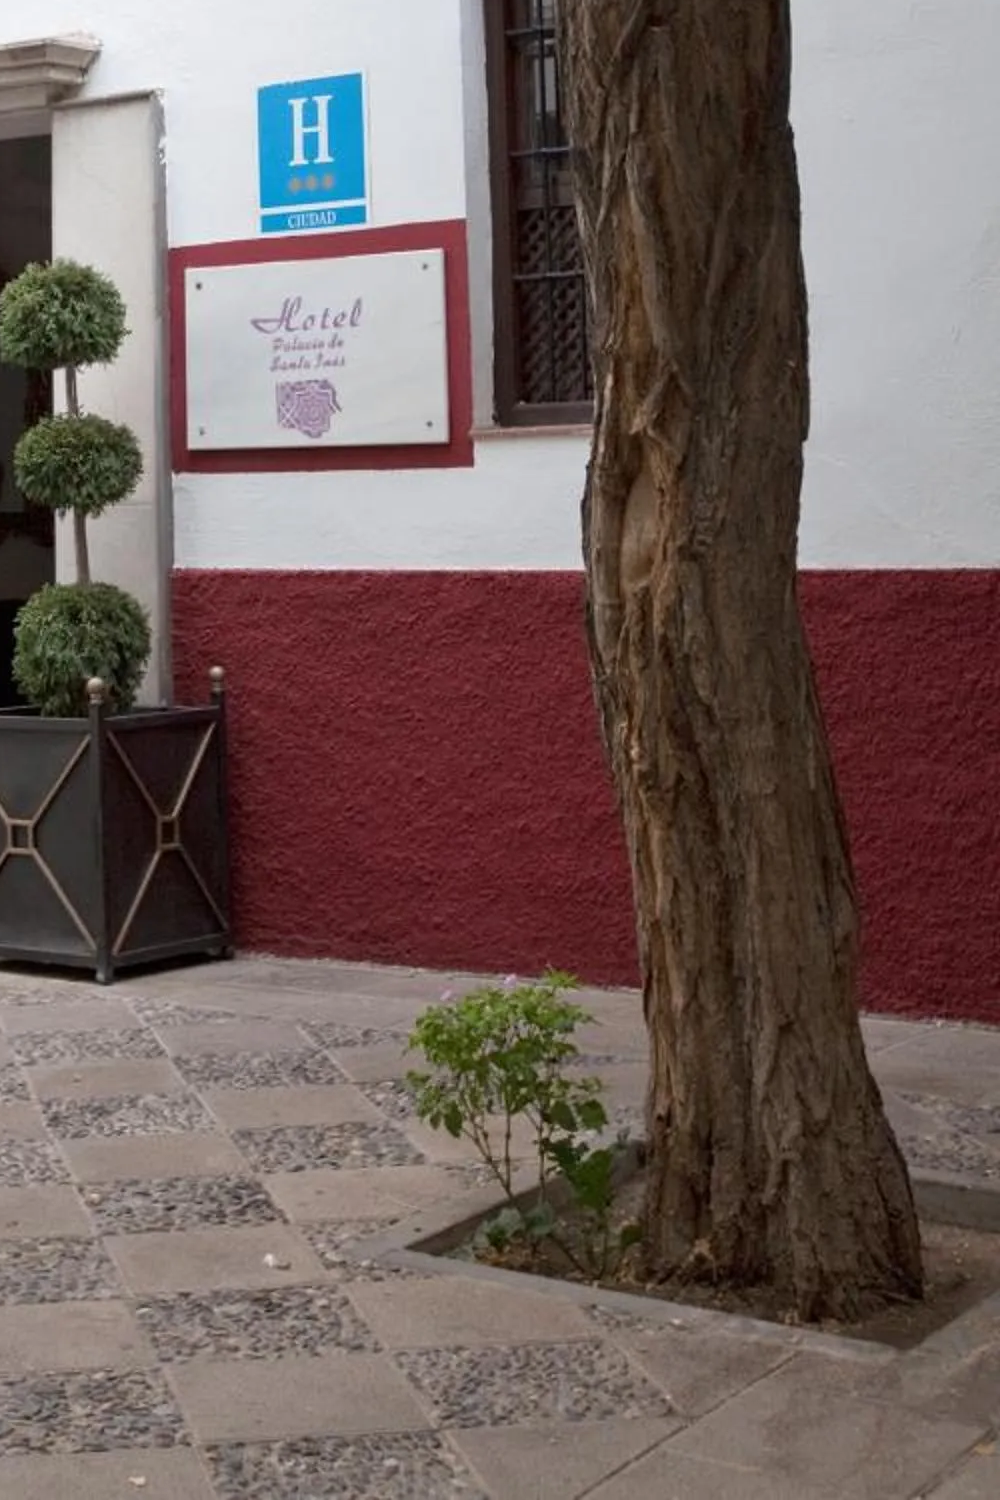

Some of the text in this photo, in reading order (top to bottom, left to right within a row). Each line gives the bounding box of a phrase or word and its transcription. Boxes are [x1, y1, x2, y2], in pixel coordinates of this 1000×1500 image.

[288, 94, 335, 167] H
[287, 211, 337, 229] CIUDAD
[250, 296, 363, 334] Hotel
[327, 332, 344, 349] de
[269, 355, 311, 372] Santa
